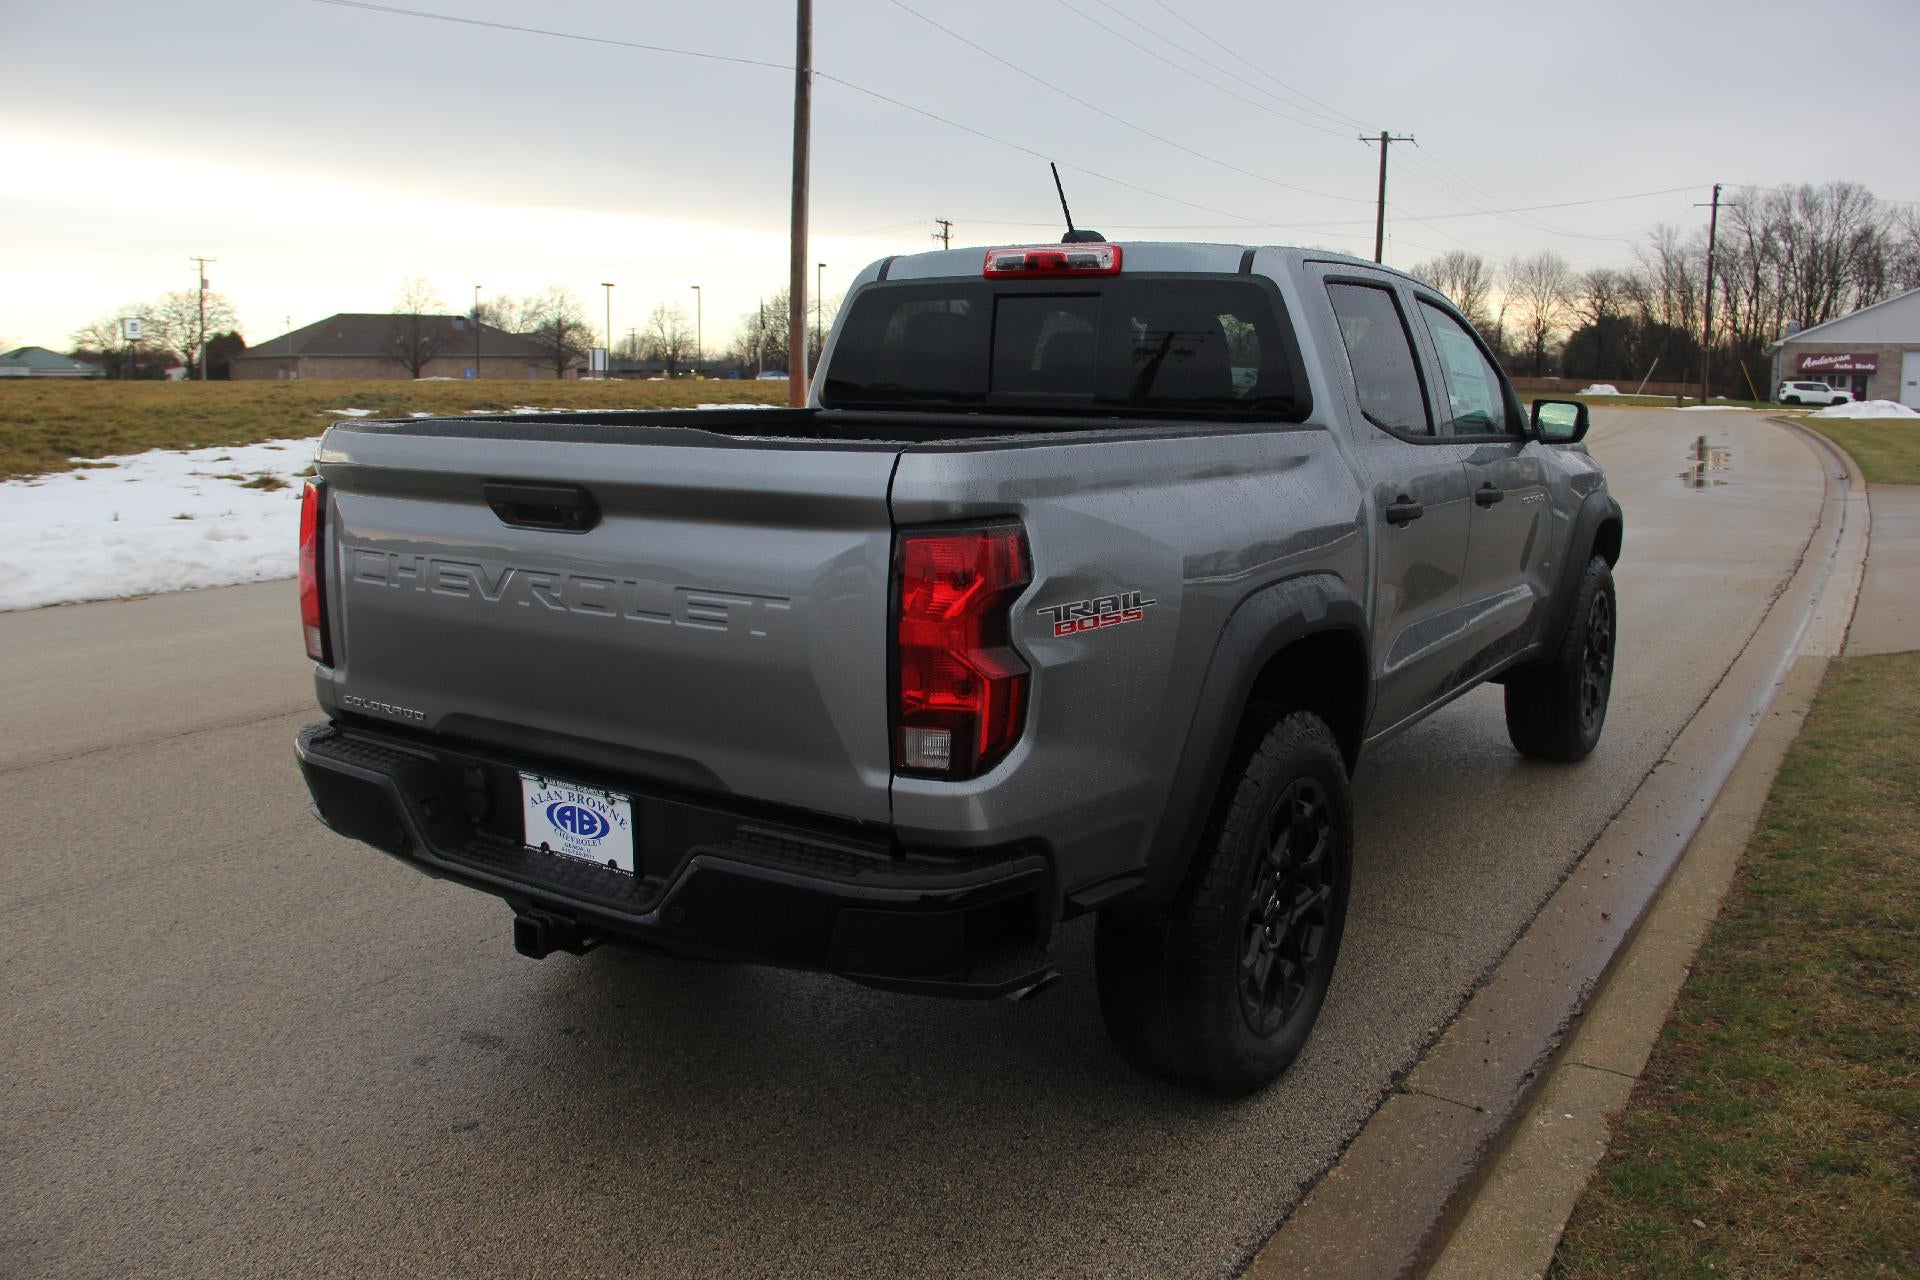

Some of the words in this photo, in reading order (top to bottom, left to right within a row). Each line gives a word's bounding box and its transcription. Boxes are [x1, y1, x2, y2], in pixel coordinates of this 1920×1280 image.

[1802, 354, 1851, 369] Anderson
[1855, 362, 1875, 371] Body
[353, 548, 791, 637] CHEVROLET
[1037, 590, 1157, 622] TRAIL
[1054, 606, 1143, 637] BOSS
[344, 695, 424, 721] COLORADO
[530, 790, 563, 808] ALAN
[568, 791, 628, 830] BROWNE
[556, 805, 598, 836] AB
[554, 827, 602, 847] CHEVROLET
